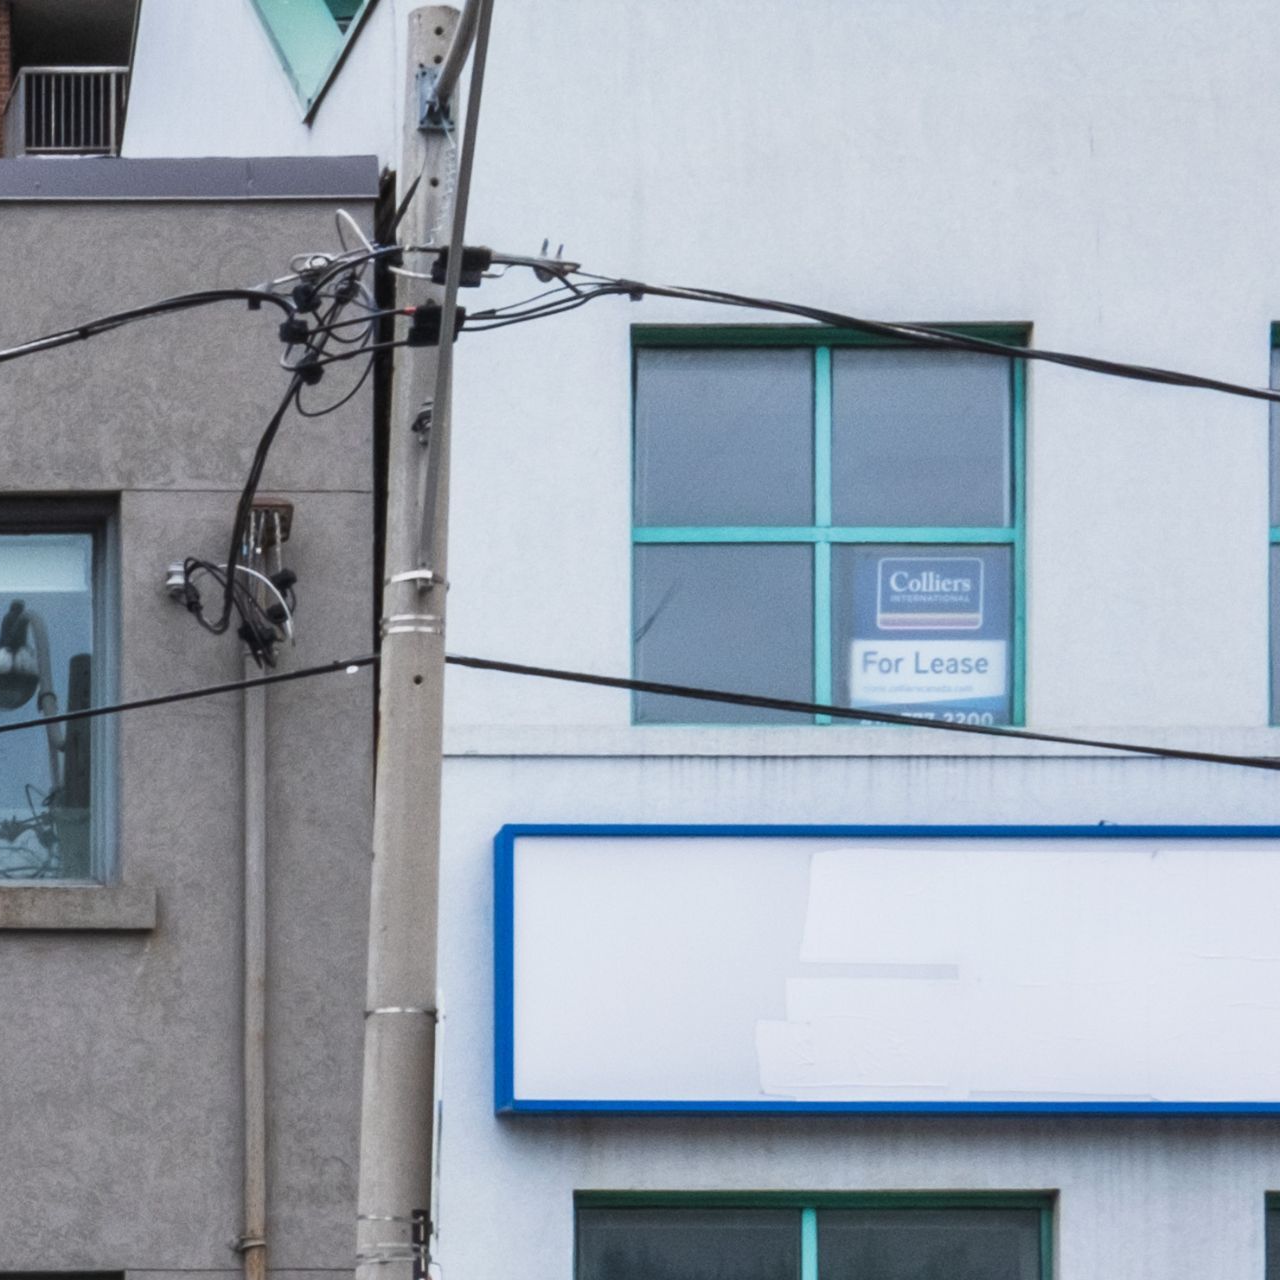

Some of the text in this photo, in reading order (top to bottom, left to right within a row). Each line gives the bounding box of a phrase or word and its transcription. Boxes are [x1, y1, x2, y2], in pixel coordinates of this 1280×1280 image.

[890, 571, 971, 592] Colliers
[890, 594, 970, 602] INTERNATIONAL
[862, 651, 989, 674] For Lease
